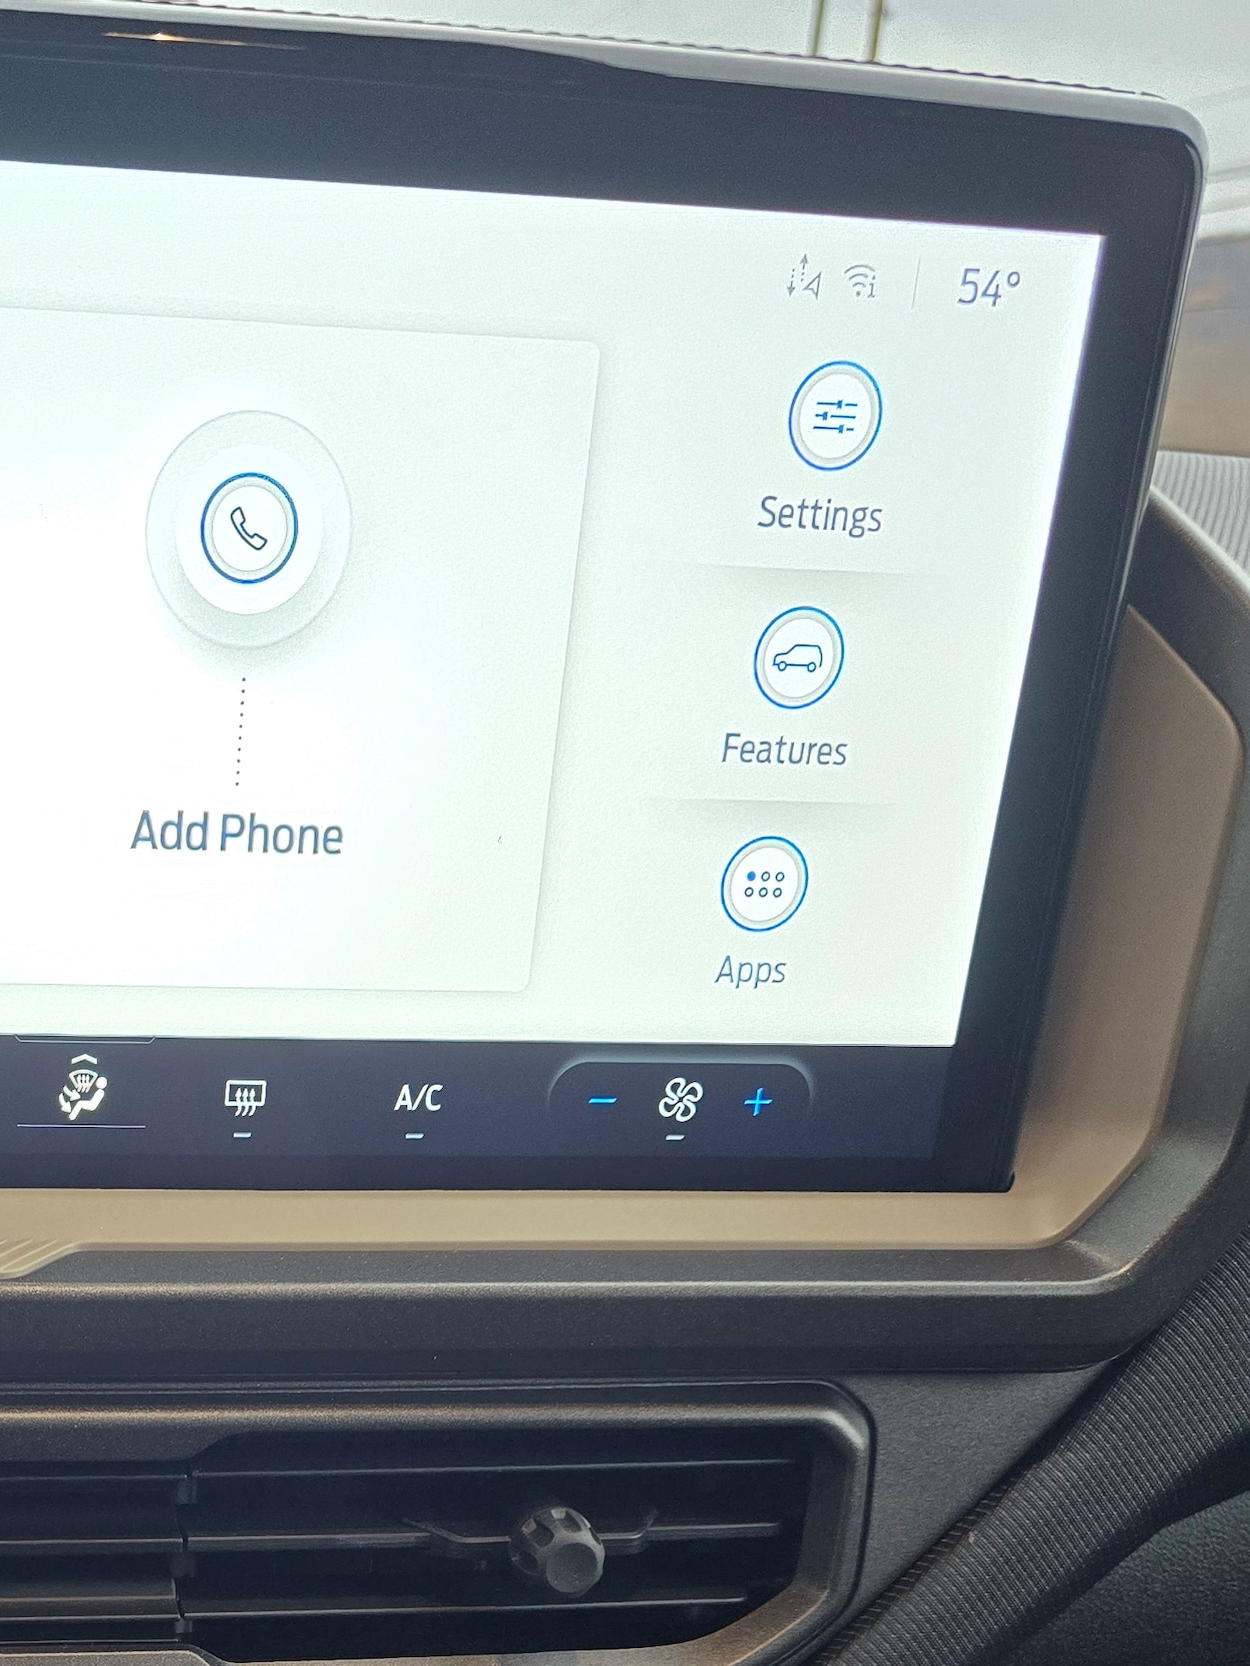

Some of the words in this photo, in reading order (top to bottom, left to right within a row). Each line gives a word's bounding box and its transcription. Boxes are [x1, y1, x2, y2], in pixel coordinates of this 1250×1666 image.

[957, 267, 1021, 307] 54°
[757, 495, 883, 539] Settings
[721, 732, 848, 767] Features
[130, 809, 209, 852] Add
[219, 812, 344, 856] Phone
[714, 955, 787, 990] Apps
[393, 1083, 444, 1112] A/C
